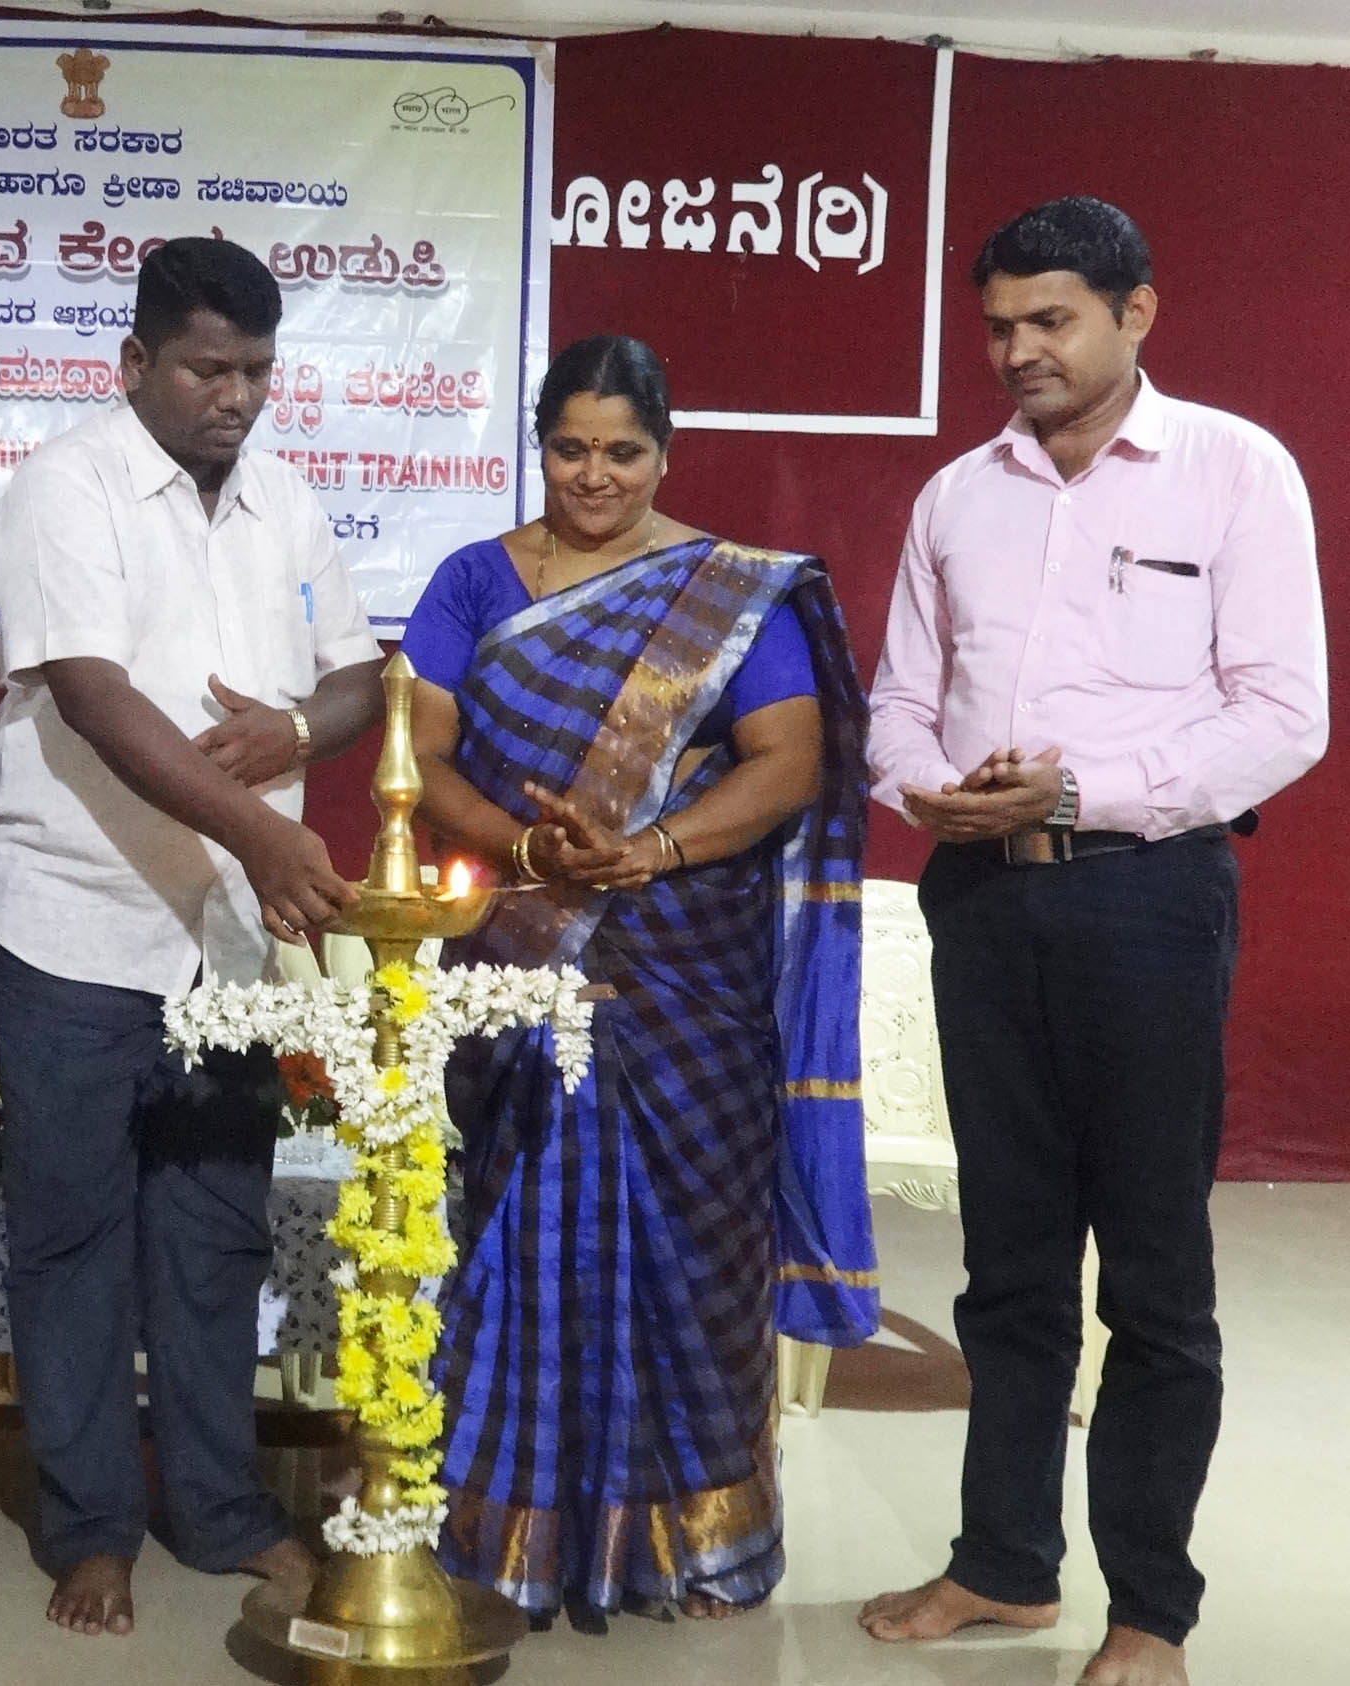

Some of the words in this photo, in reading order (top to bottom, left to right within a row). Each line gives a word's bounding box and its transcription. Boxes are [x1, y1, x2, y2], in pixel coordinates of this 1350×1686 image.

[74, 124, 182, 155] ಸರಕಾರ
[103, 173, 180, 207] ಕ್ರೀಡಾ
[197, 174, 348, 207] ಸಚಿವಾಲಯ
[268, 234, 447, 287] ಉಡುಪಿ
[53, 299, 137, 336] ಆಶ್ರಯ
[358, 453, 507, 490] TRAINING
[329, 513, 381, 540] ರೆಗೆ
